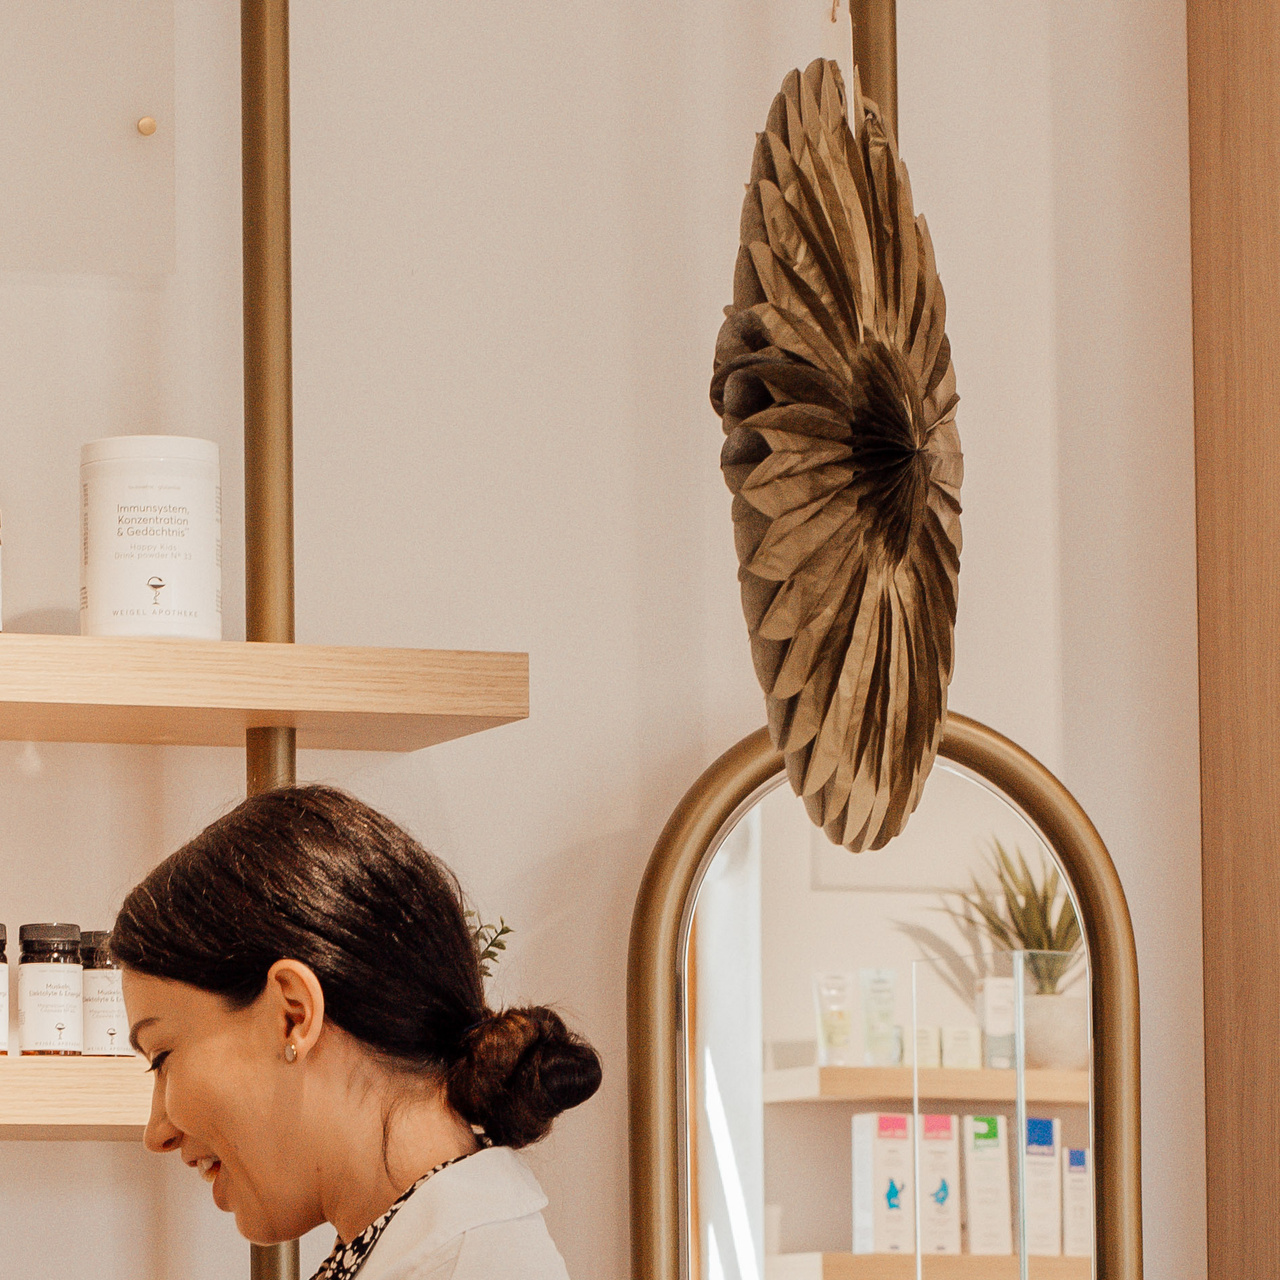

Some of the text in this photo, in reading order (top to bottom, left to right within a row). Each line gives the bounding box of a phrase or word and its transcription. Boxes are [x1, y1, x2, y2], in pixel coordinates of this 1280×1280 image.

[117, 504, 190, 516] Immunsystem,
[118, 514, 189, 526] Konzentration
[117, 527, 124, 537] &
[112, 608, 199, 618] WEIGEL APOTHEKE
